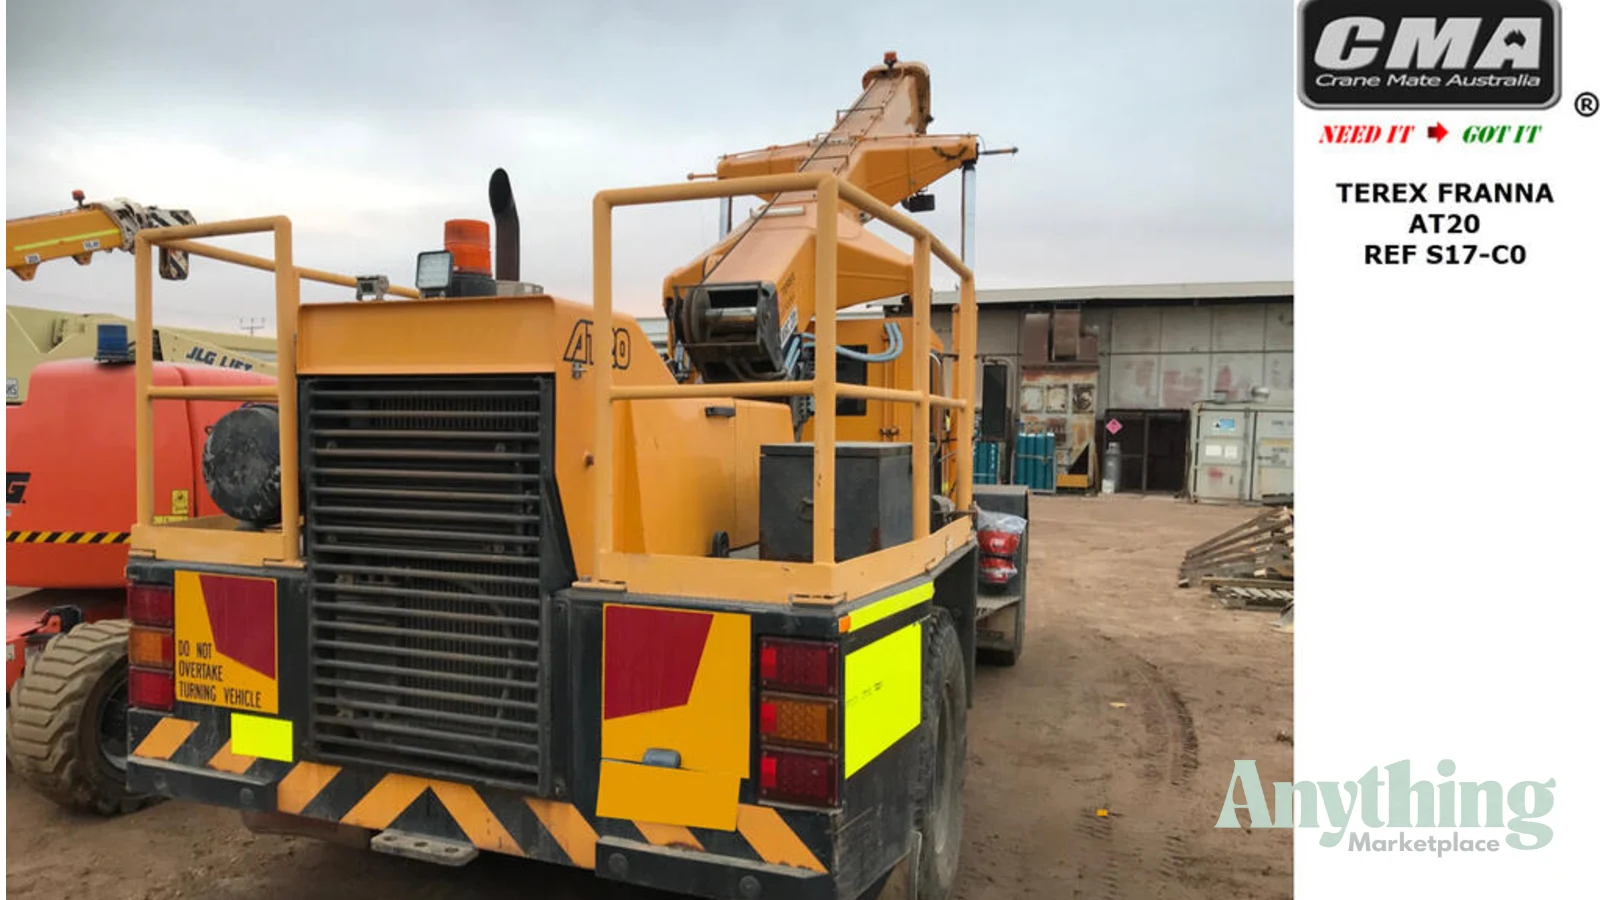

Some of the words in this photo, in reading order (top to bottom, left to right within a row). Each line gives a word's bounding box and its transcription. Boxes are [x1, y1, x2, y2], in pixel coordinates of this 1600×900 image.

[563, 318, 631, 370] A0
[185, 346, 217, 366] JLG
[178, 640, 190, 656] DO
[196, 642, 212, 658] NOT
[179, 660, 223, 682] OVERTAKE
[179, 681, 216, 702] TURNING
[223, 687, 262, 708] VEHICLE
